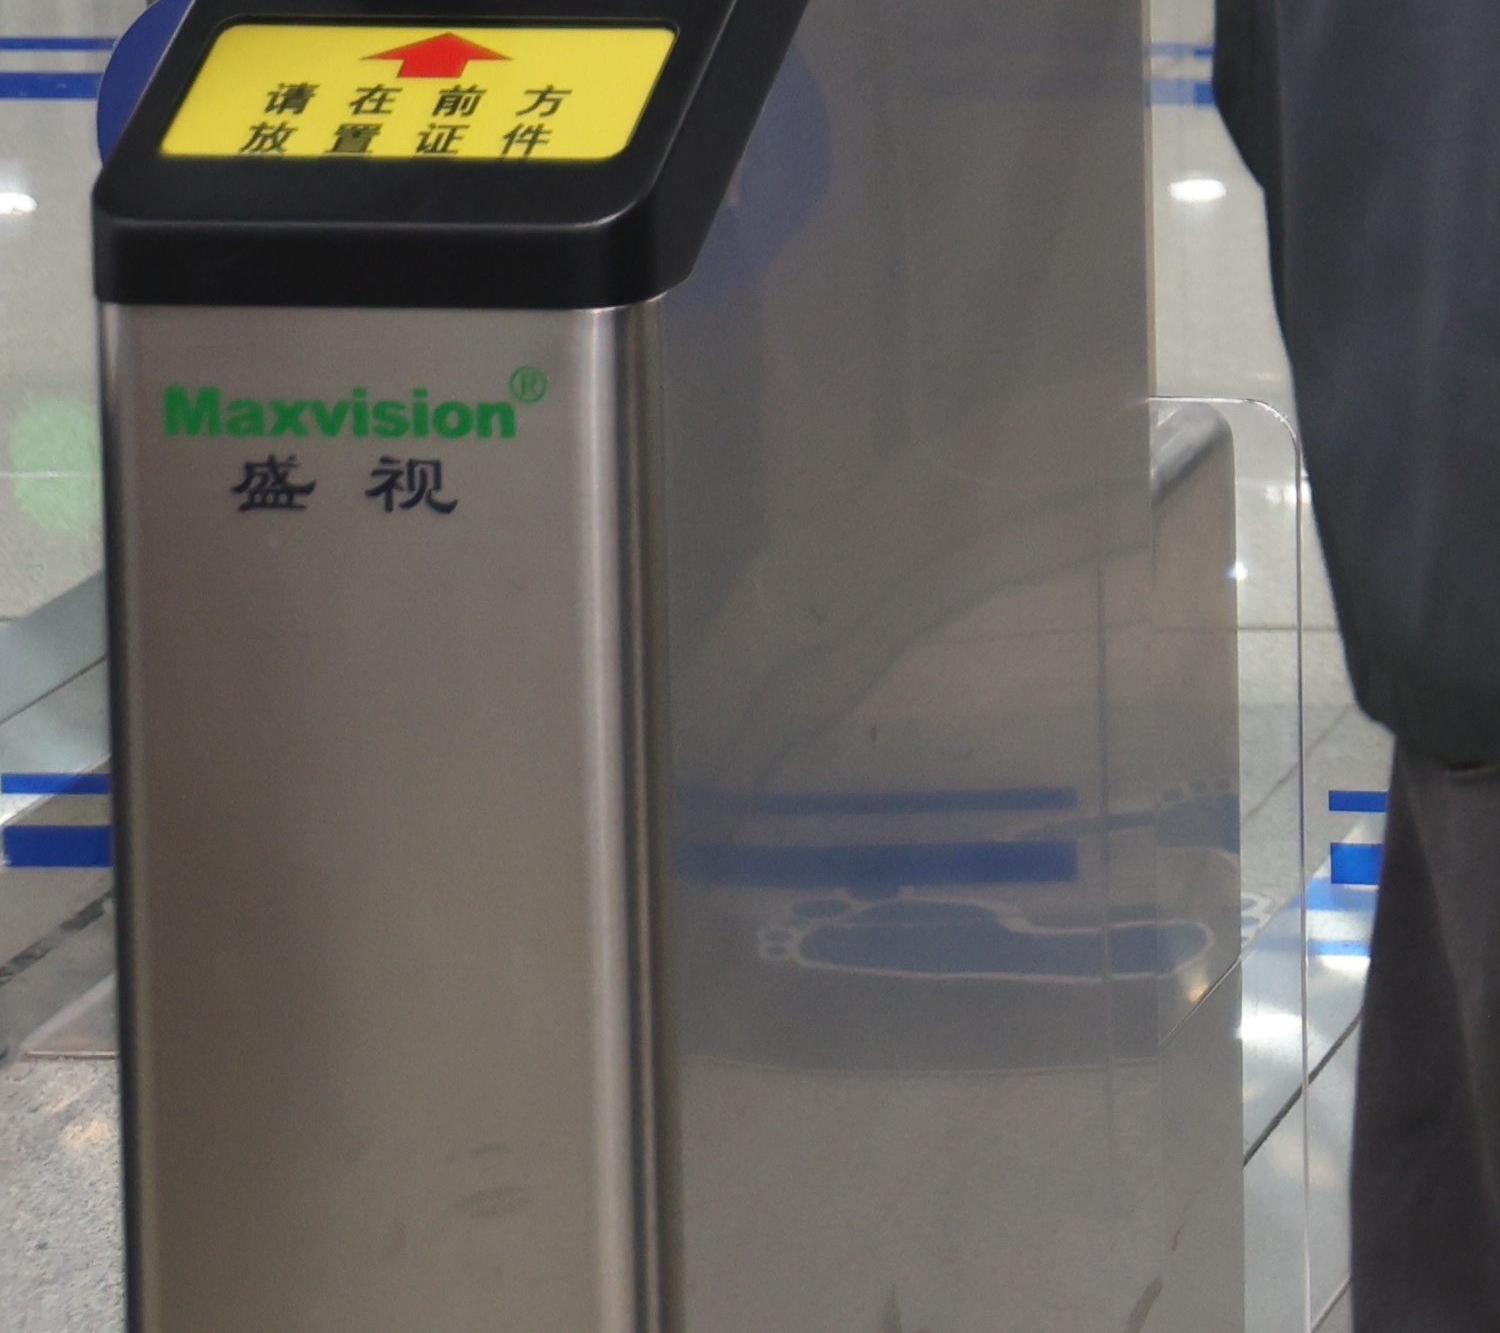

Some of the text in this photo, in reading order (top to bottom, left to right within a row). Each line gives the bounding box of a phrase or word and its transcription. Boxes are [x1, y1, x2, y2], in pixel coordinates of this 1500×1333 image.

[265, 82, 571, 117] 请在前方
[239, 123, 553, 156] 放置证件
[232, 455, 457, 514] 盛视
